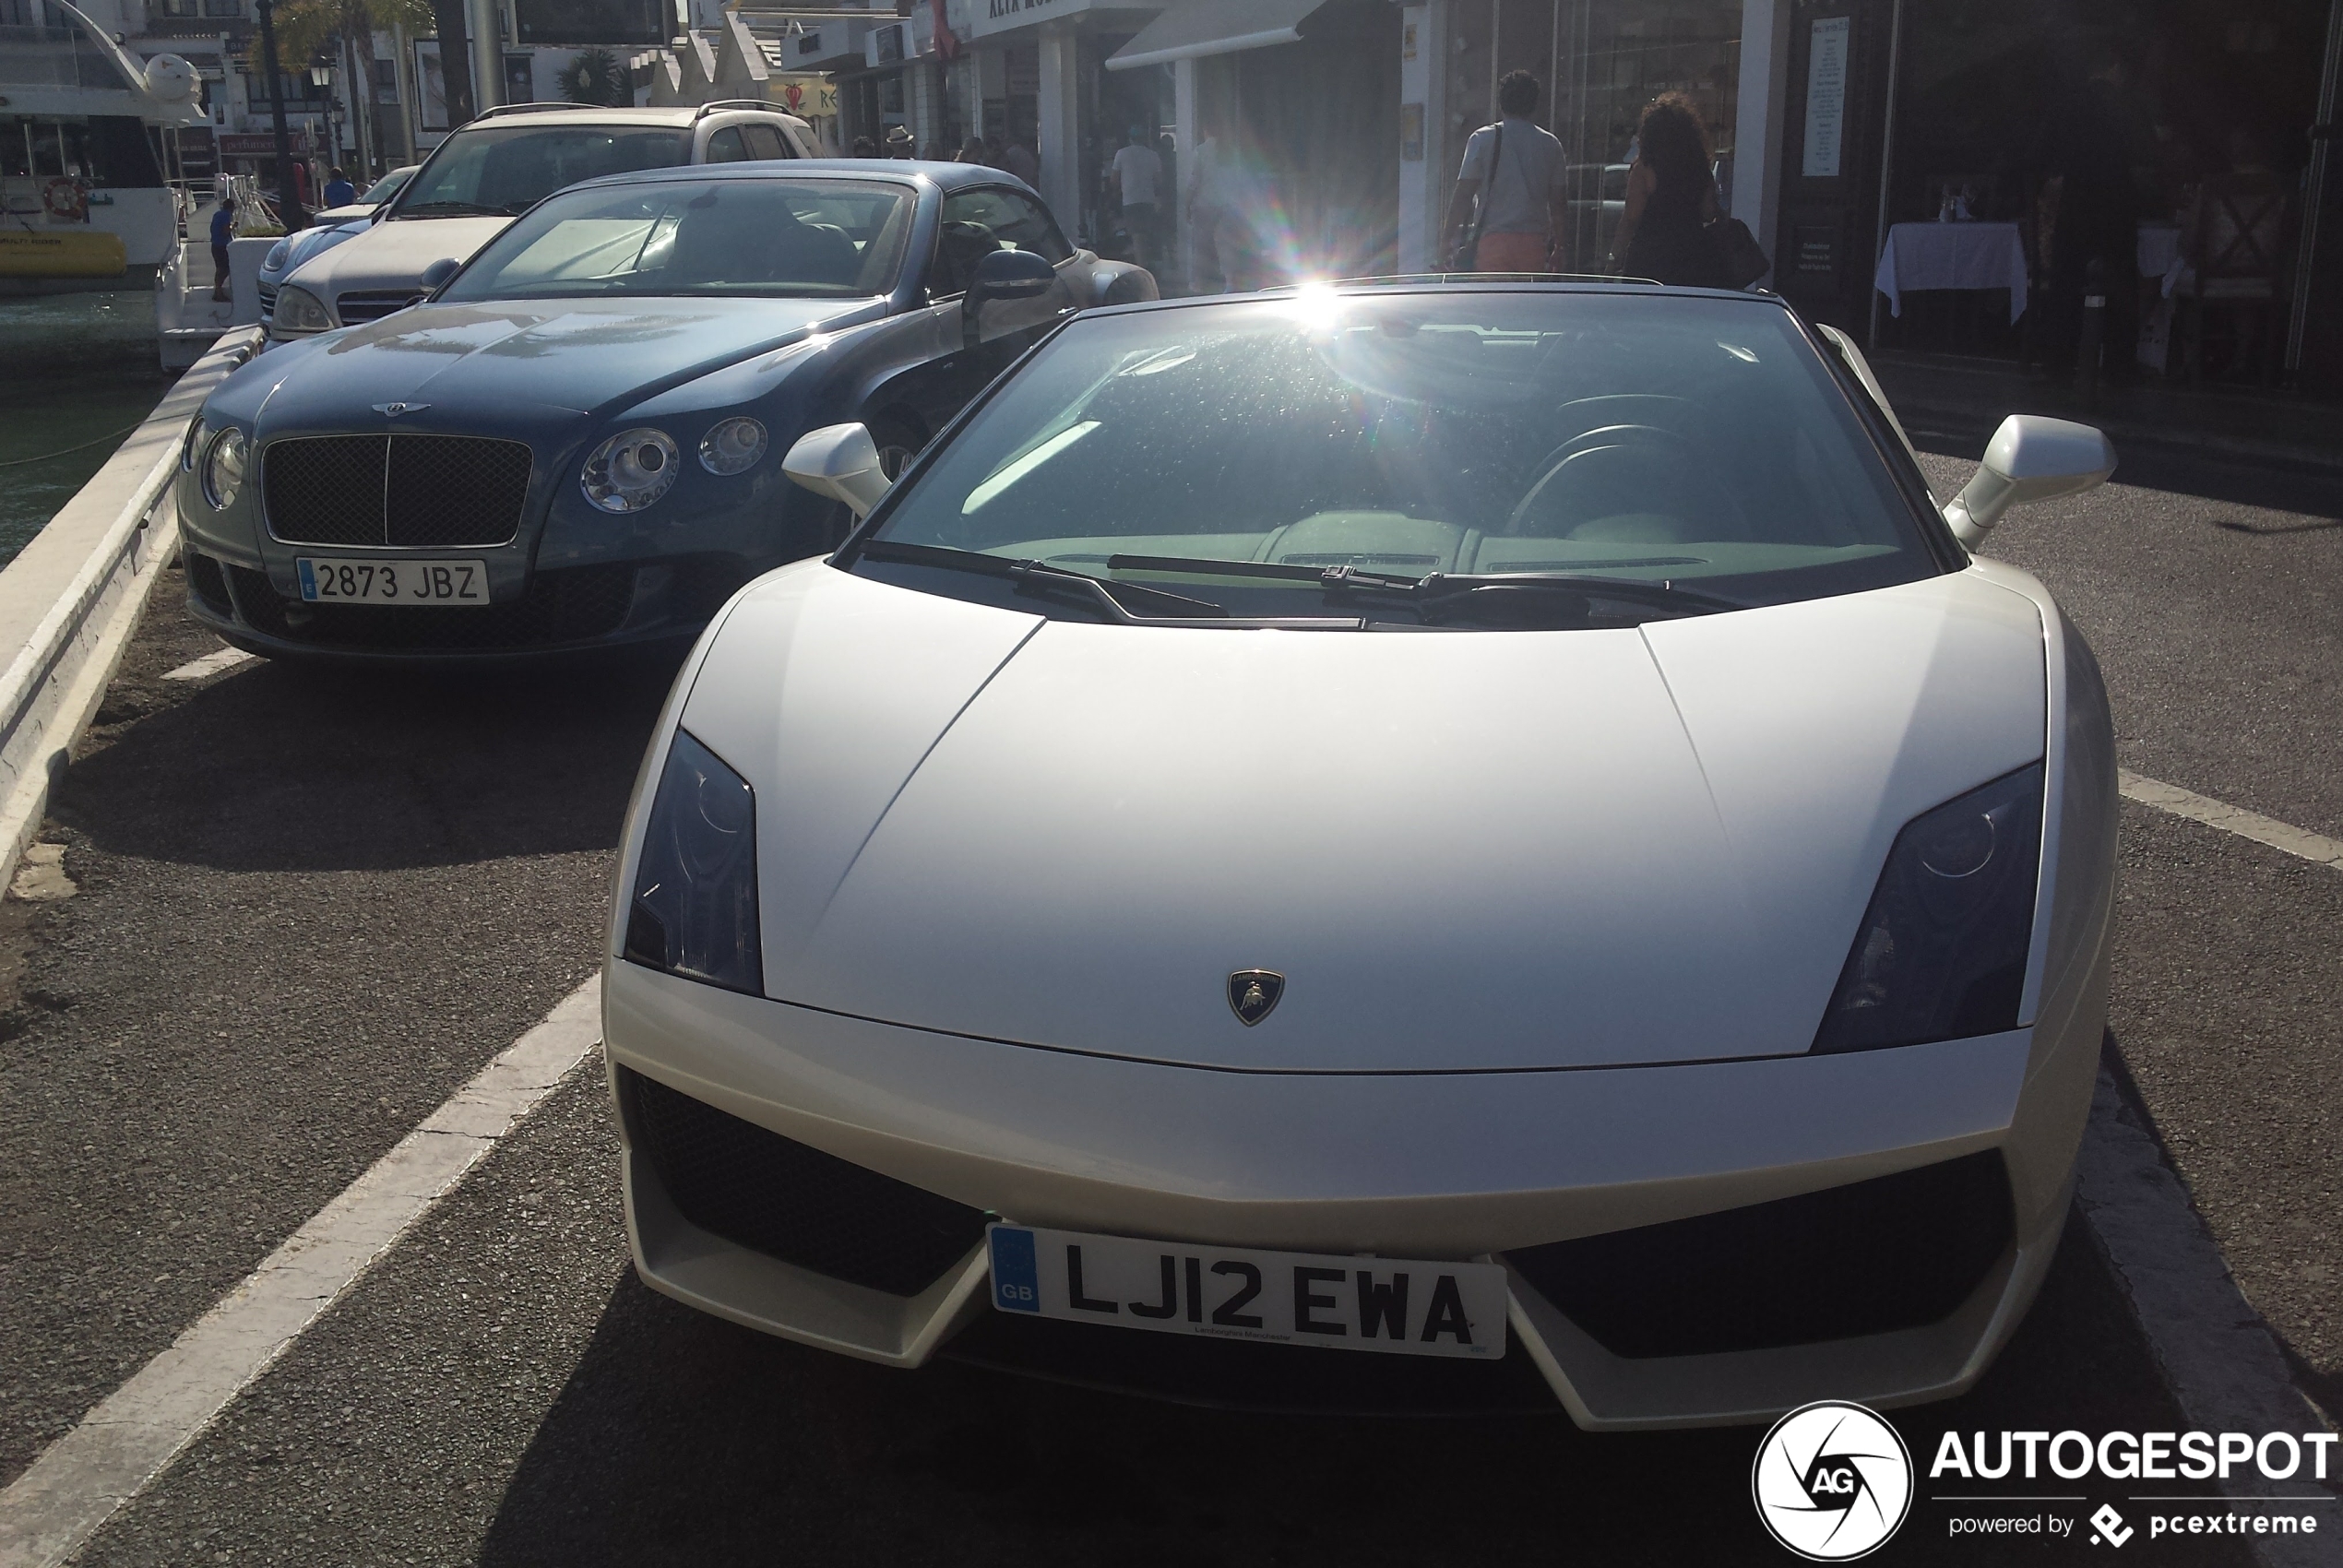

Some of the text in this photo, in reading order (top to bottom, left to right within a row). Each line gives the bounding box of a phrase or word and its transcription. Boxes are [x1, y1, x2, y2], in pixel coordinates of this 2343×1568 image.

[227, 139, 276, 152] perfumeri
[305, 583, 313, 593] E
[318, 564, 478, 599] 2873 JBZ
[1232, 973, 1279, 983] LAMBORGHINI
[1001, 1283, 1033, 1301] GB
[1066, 1244, 1473, 1345] LJ12 EWA
[1195, 1326, 1291, 1341] Lamborghini Manchester
